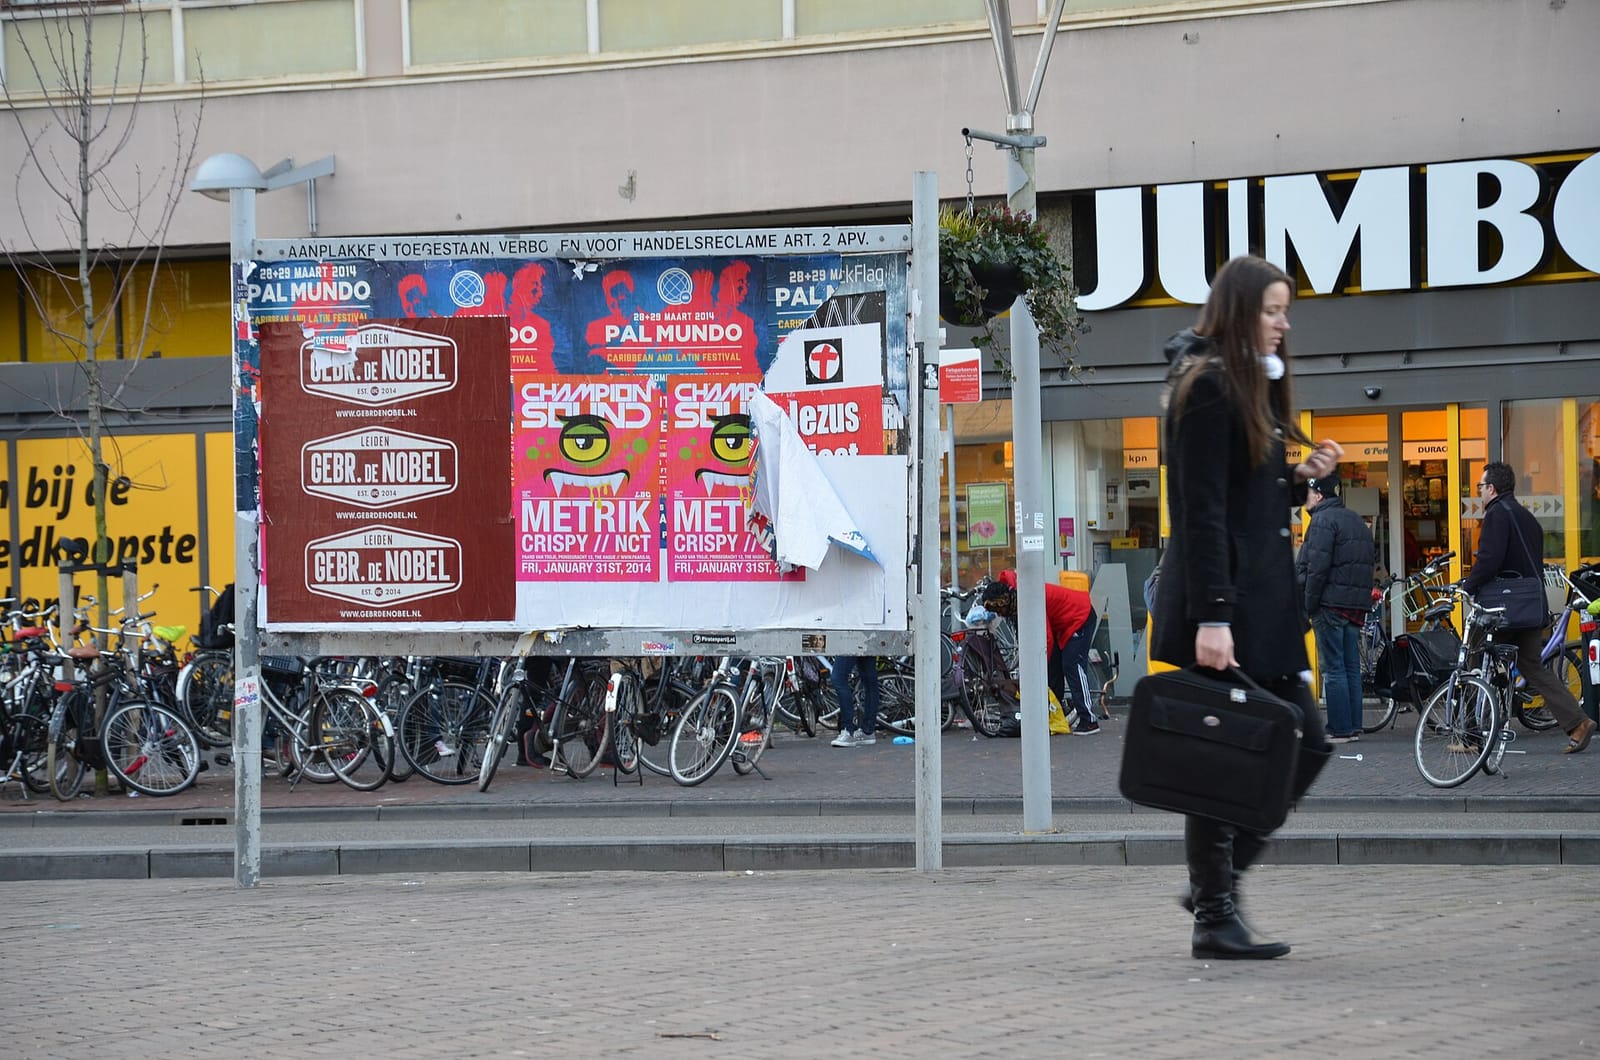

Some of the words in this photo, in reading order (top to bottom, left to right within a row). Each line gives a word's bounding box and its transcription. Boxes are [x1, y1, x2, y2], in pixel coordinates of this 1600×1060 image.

[393, 241, 494, 256] TOEGESTAAN,
[633, 233, 777, 250] HANDELSRECLAME
[784, 233, 816, 246] ART.
[822, 233, 831, 246] 2
[837, 231, 869, 245] APV.
[260, 267, 291, 280] 28+29
[294, 265, 329, 278] MAART
[332, 265, 357, 277] 2014
[788, 269, 827, 283] 28+29
[248, 282, 288, 304] PAL
[291, 280, 371, 302] MUNDO
[308, 313, 331, 325] LATIN
[333, 312, 368, 323] FESTIVAL
[633, 312, 661, 322] 28+29
[664, 312, 692, 321] MAART
[695, 311, 715, 321] 2014
[360, 333, 389, 345] LEIDEN
[605, 325, 652, 343] PAL
[656, 323, 743, 342] MUNDO
[511, 355, 537, 364] TIVAL
[607, 353, 654, 363] CARIBBEAN
[656, 353, 673, 362] AND
[676, 352, 700, 362] LATIN
[702, 351, 742, 361] FESTIVAL
[364, 361, 379, 381] DE
[381, 348, 446, 380] NOBEL
[521, 383, 652, 402] CHAMPION
[674, 382, 760, 402] CHAMP
[336, 409, 418, 418] WWW.GEBRDENOBEL.NL
[521, 401, 652, 429] SOUND
[360, 435, 390, 447] LEIDEN
[1417, 446, 1448, 454] DURAC
[1128, 455, 1147, 464] kpn
[311, 452, 362, 484] GEBR.
[364, 463, 379, 483] DE
[381, 451, 446, 483] NOBEL
[25, 464, 76, 520] bij
[336, 511, 418, 520] WWW.GEBRDENOBEL.NL
[521, 500, 651, 533] METRIK
[674, 500, 751, 533] MET
[0, 526, 196, 567] edkoopste
[364, 534, 393, 546] LEIDEN
[521, 534, 589, 553] CRISPY
[615, 534, 652, 553] NCT
[674, 534, 738, 553] CRISPY
[314, 550, 366, 583] GEBR.
[368, 562, 382, 582] DE
[385, 549, 451, 582] NOBEL
[521, 563, 542, 574] FRI,
[544, 562, 593, 573] JANUARY
[596, 562, 624, 575] 31ST,
[625, 562, 652, 573] 2014
[674, 563, 694, 575] FRI,
[696, 562, 743, 573] JANUARY
[746, 562, 772, 574] 31ST,
[361, 588, 373, 596] EST.
[385, 588, 401, 596] 2014
[340, 610, 422, 619] WWW.GEBRDENOBEL.NL
